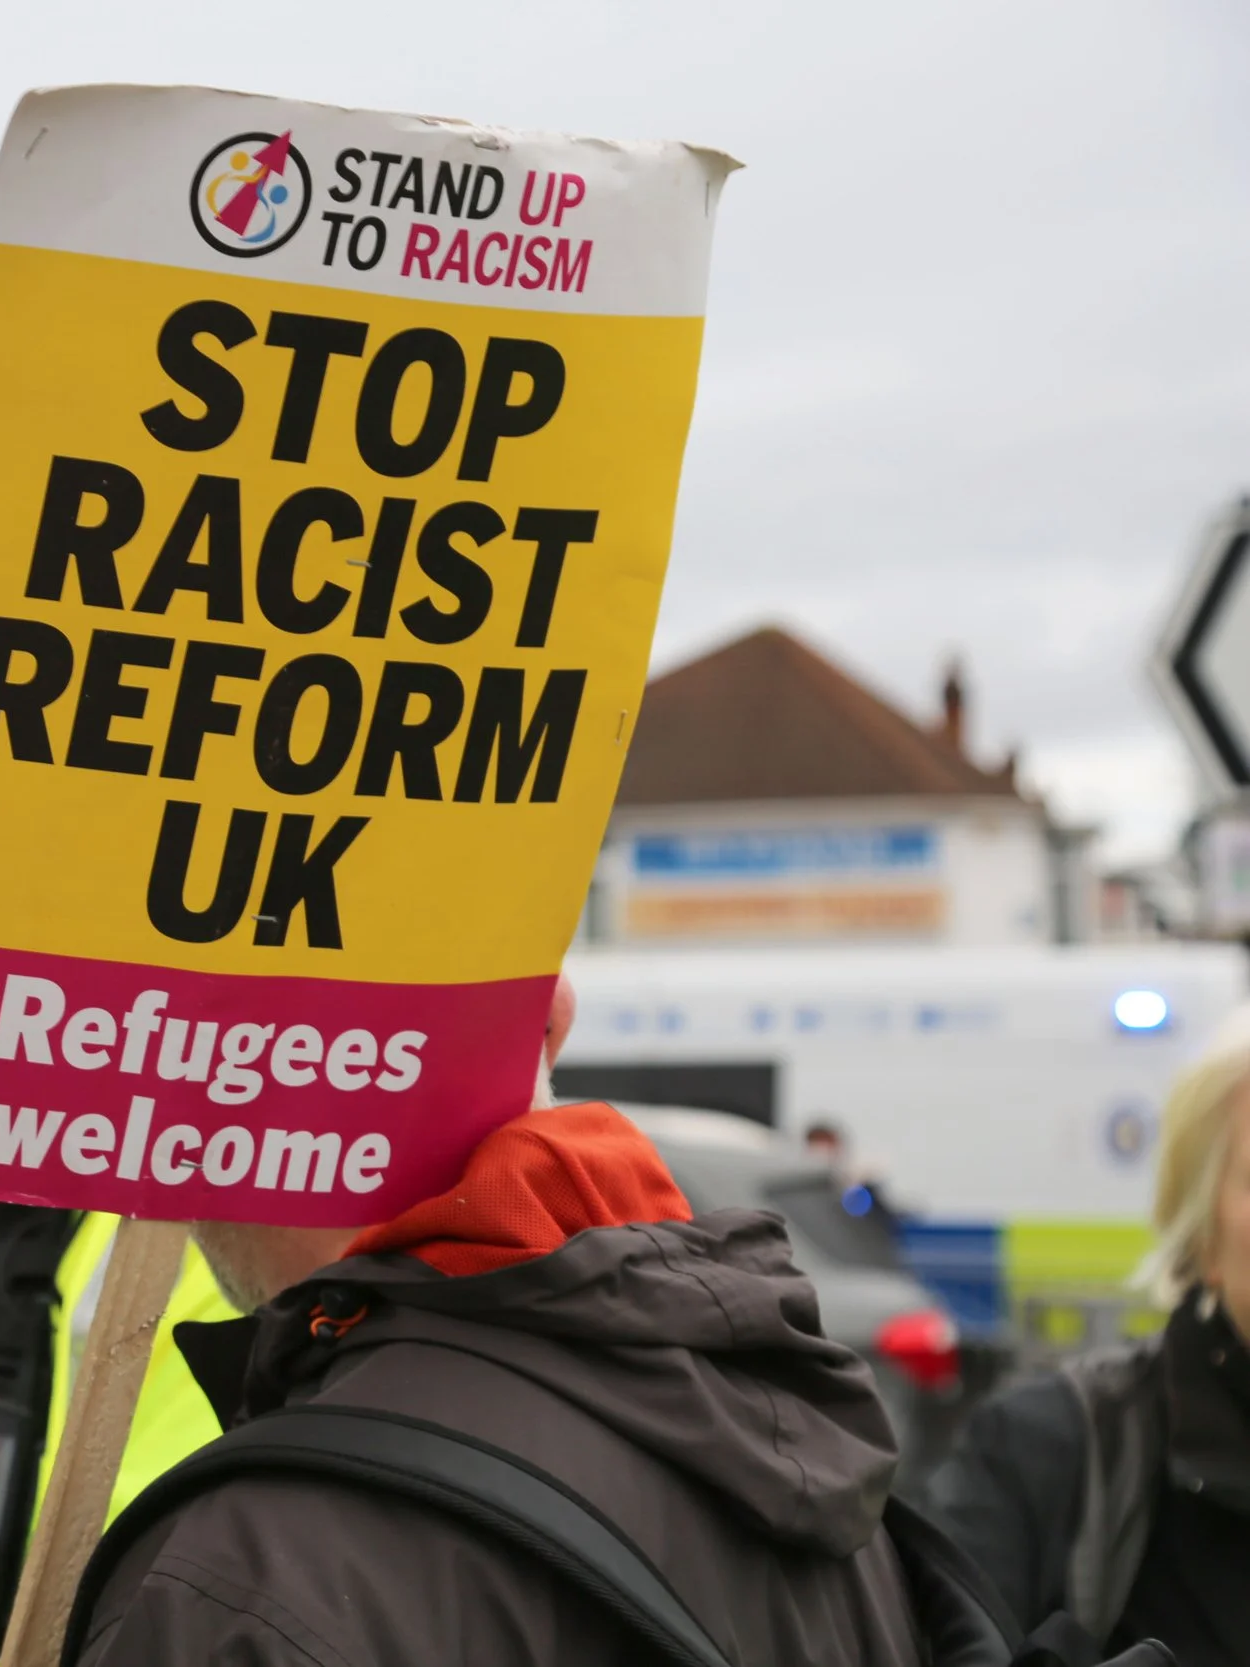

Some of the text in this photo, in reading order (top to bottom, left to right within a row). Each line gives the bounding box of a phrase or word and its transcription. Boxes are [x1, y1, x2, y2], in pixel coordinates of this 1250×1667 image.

[321, 210, 594, 294] TO RACISM
[327, 147, 587, 229] STAND UP
[140, 299, 566, 482] STOP
[24, 455, 600, 648] RACIST
[146, 799, 371, 950] UK
